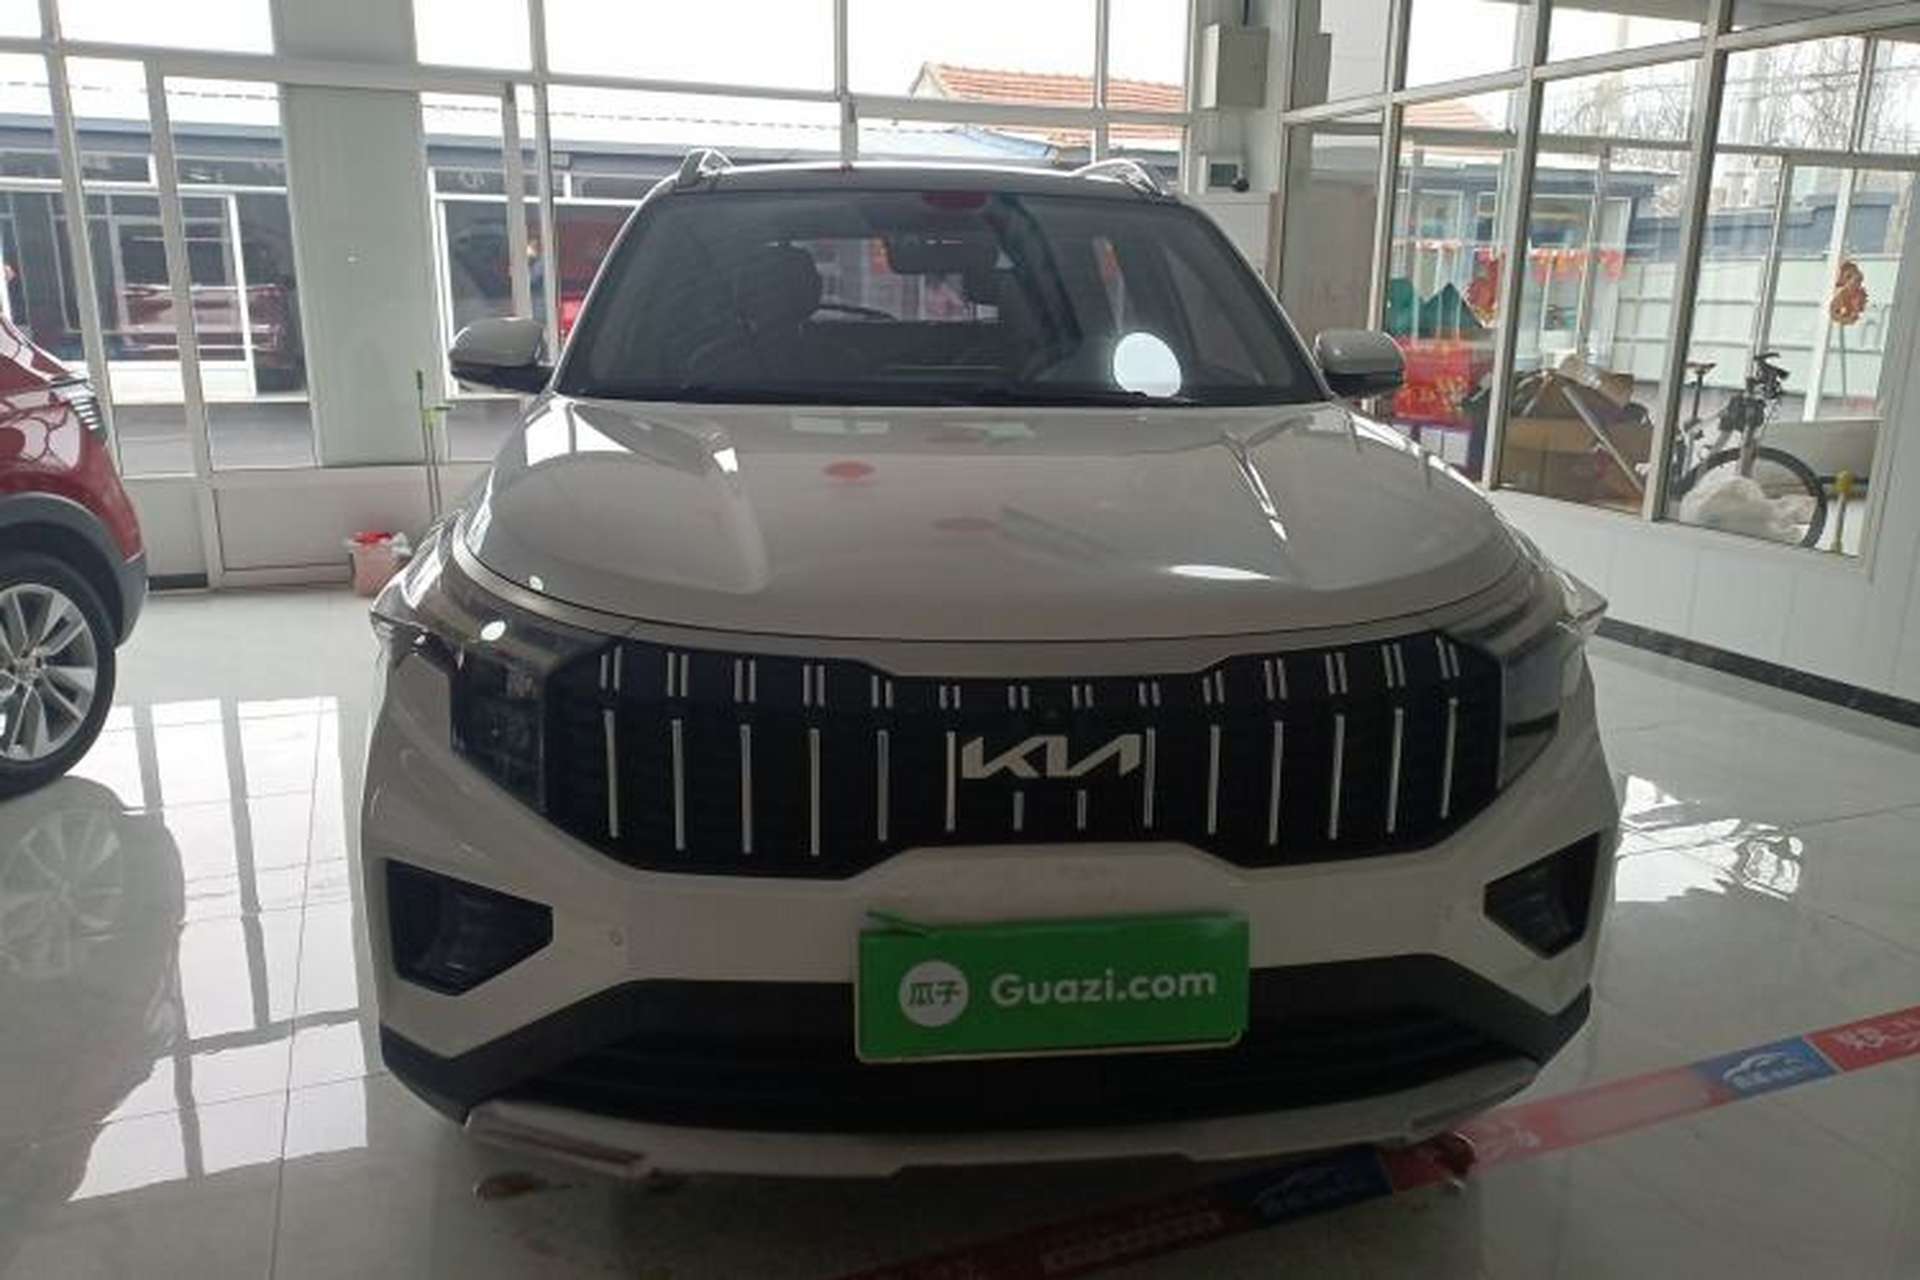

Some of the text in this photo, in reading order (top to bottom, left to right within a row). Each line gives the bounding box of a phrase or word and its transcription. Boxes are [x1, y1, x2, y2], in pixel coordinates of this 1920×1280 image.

[962, 734, 1141, 779] KIA
[908, 979, 963, 1007] 瓜子
[989, 968, 1217, 1007] Guazi.com
